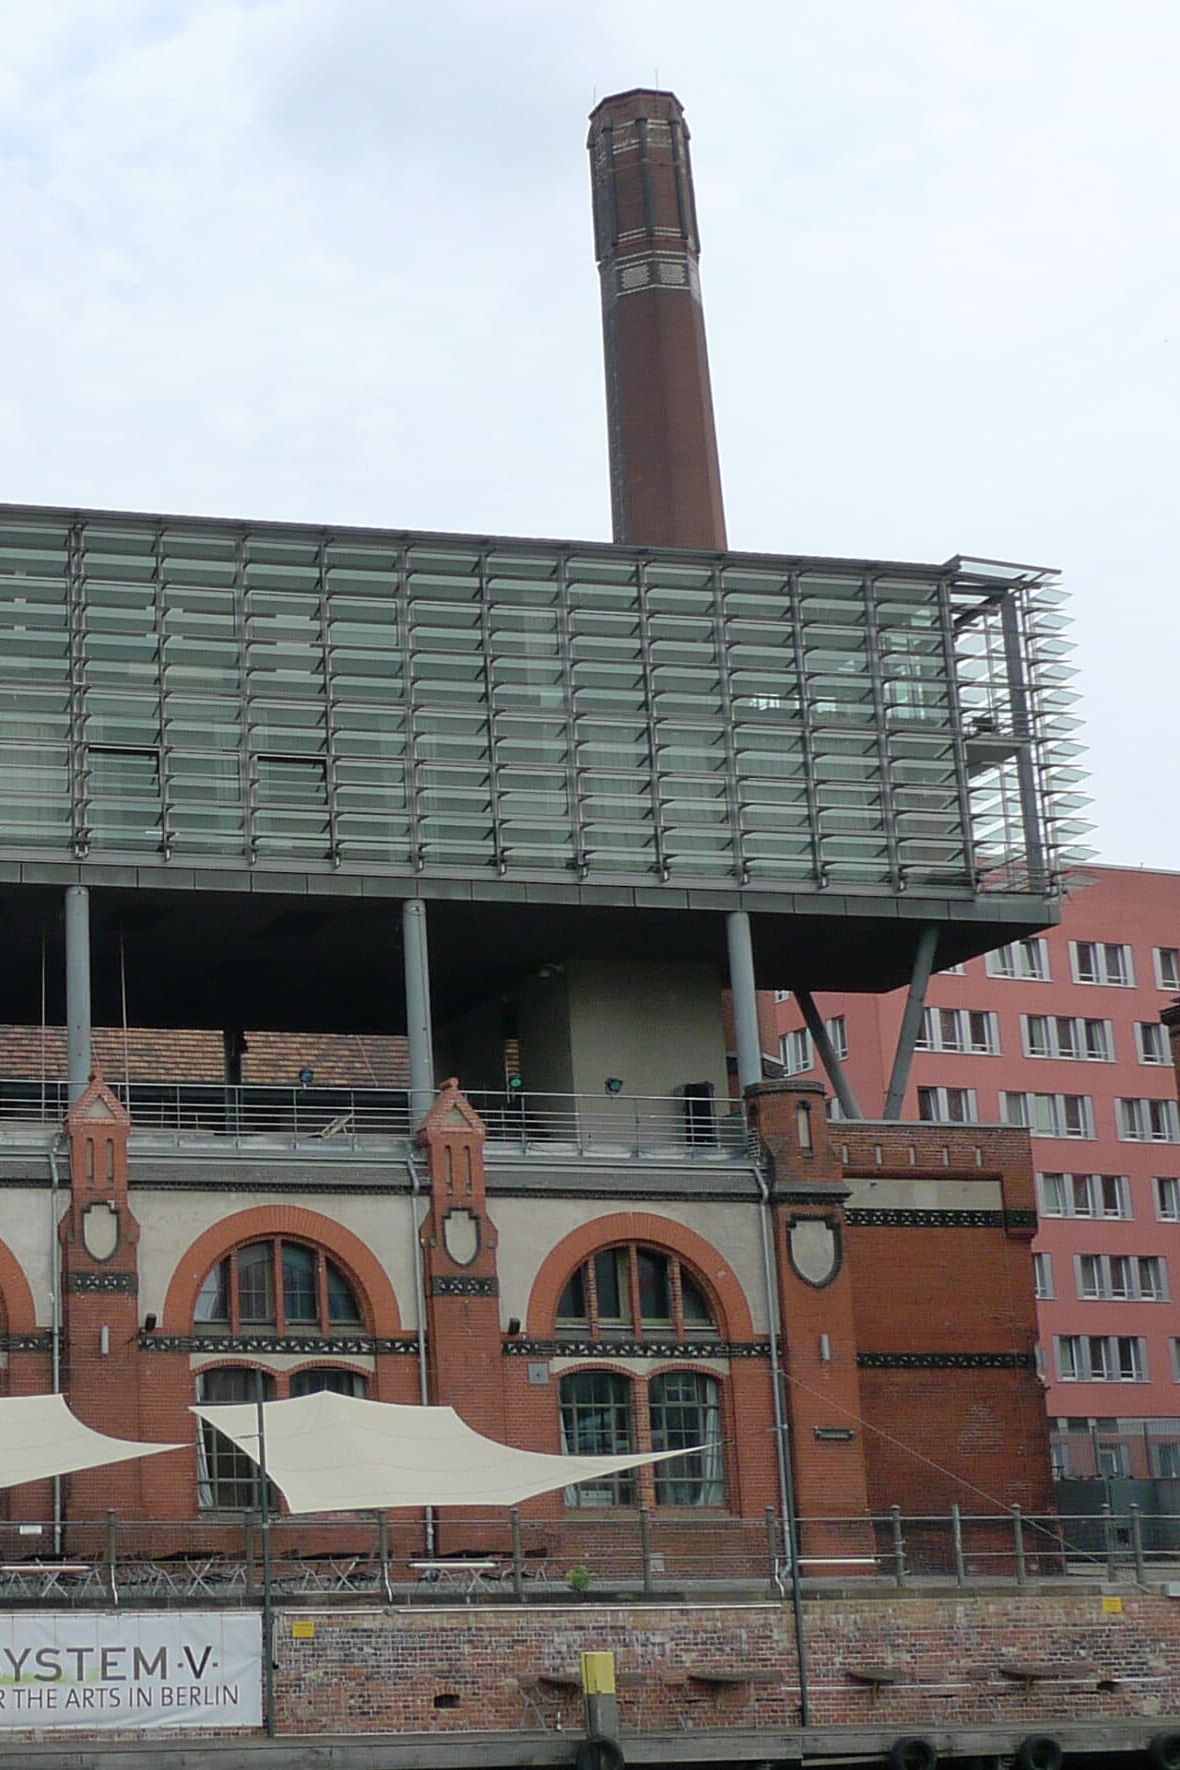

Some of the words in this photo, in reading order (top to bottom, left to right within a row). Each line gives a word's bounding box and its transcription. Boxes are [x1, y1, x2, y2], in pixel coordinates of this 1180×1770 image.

[12, 1688, 58, 1710] THE
[64, 1687, 121, 1708] ARTS
[129, 1687, 152, 1708] IN
[161, 1685, 239, 1707] BERLIN
